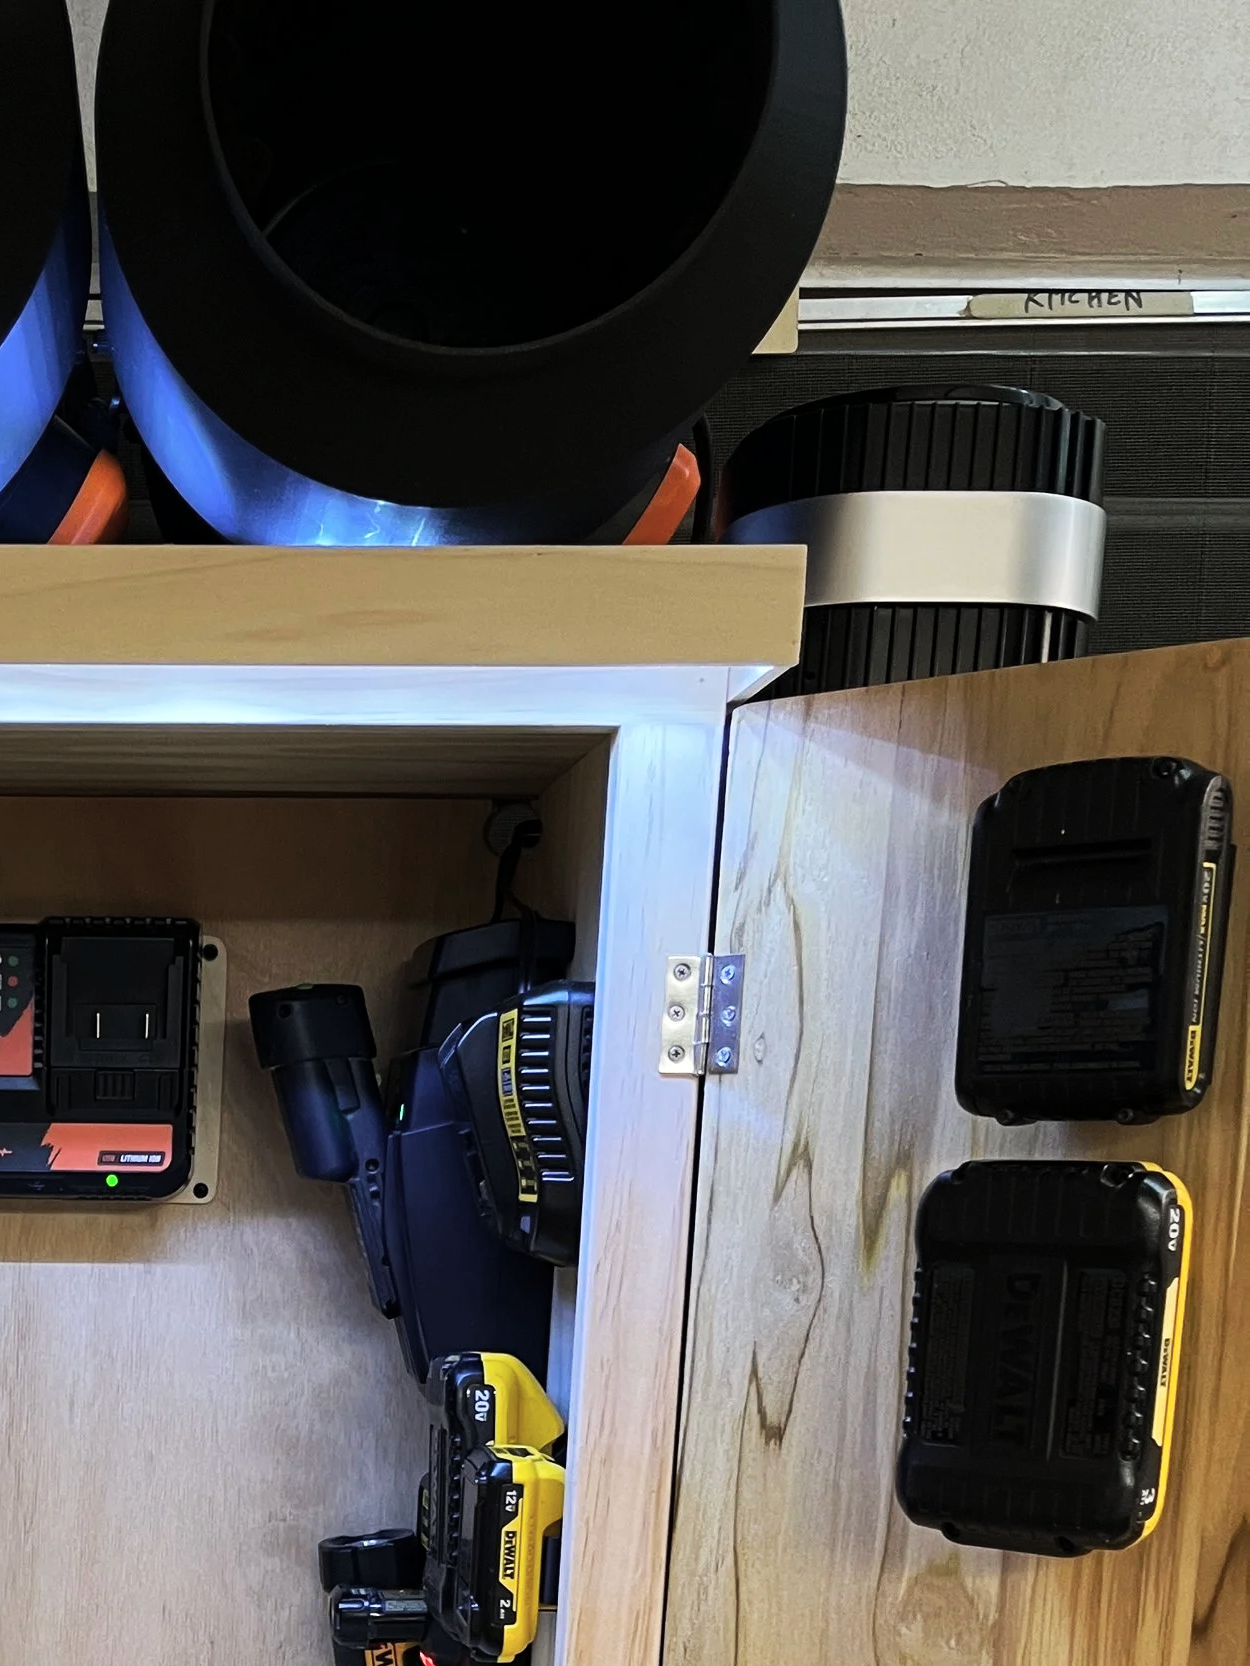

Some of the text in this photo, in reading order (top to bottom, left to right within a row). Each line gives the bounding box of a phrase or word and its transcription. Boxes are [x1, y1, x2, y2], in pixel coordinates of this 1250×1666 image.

[1023, 290, 1143, 314] KITCHEN
[1168, 1207, 1181, 1251] 20V
[474, 1389, 490, 1422] 20V
[505, 1489, 517, 1512] 12V
[503, 1531, 517, 1580] DEWALT
